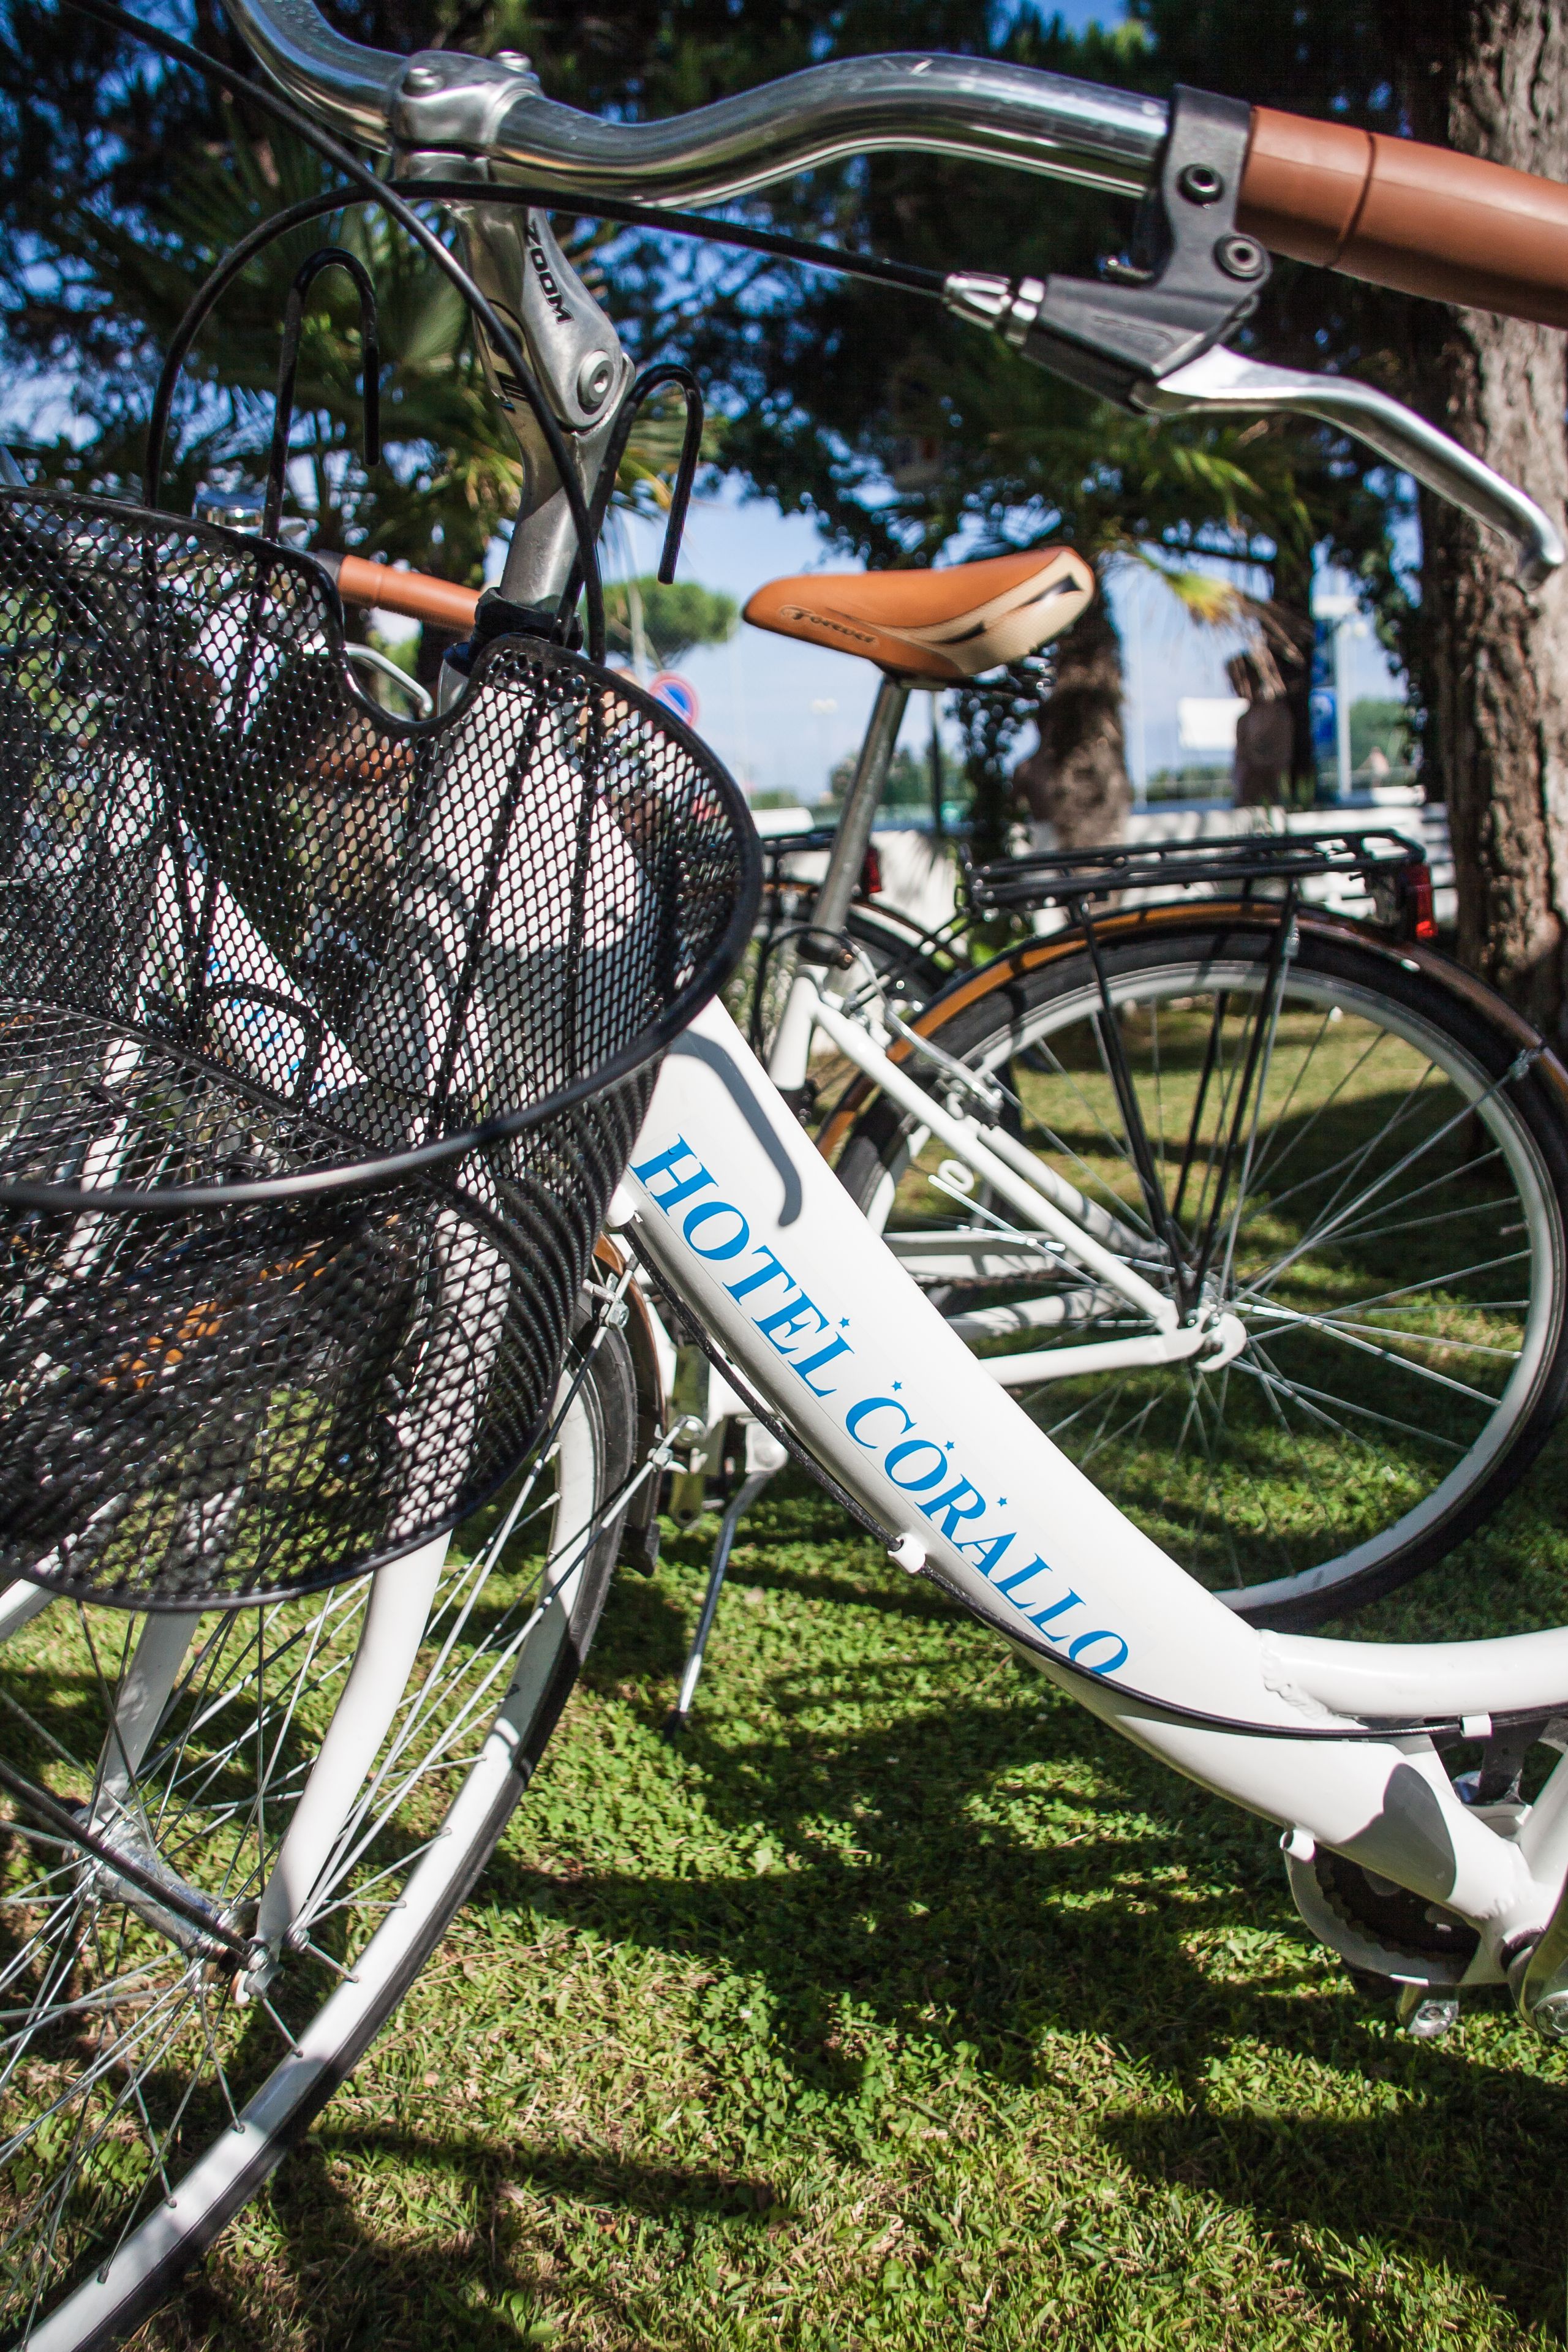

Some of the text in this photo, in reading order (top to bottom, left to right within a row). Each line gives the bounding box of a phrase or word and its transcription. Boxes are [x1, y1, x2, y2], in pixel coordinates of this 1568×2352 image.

[526, 218, 575, 325] ZOOM
[780, 605, 878, 646] Forever
[628, 1133, 1129, 1676] HOTEL CORALLO
